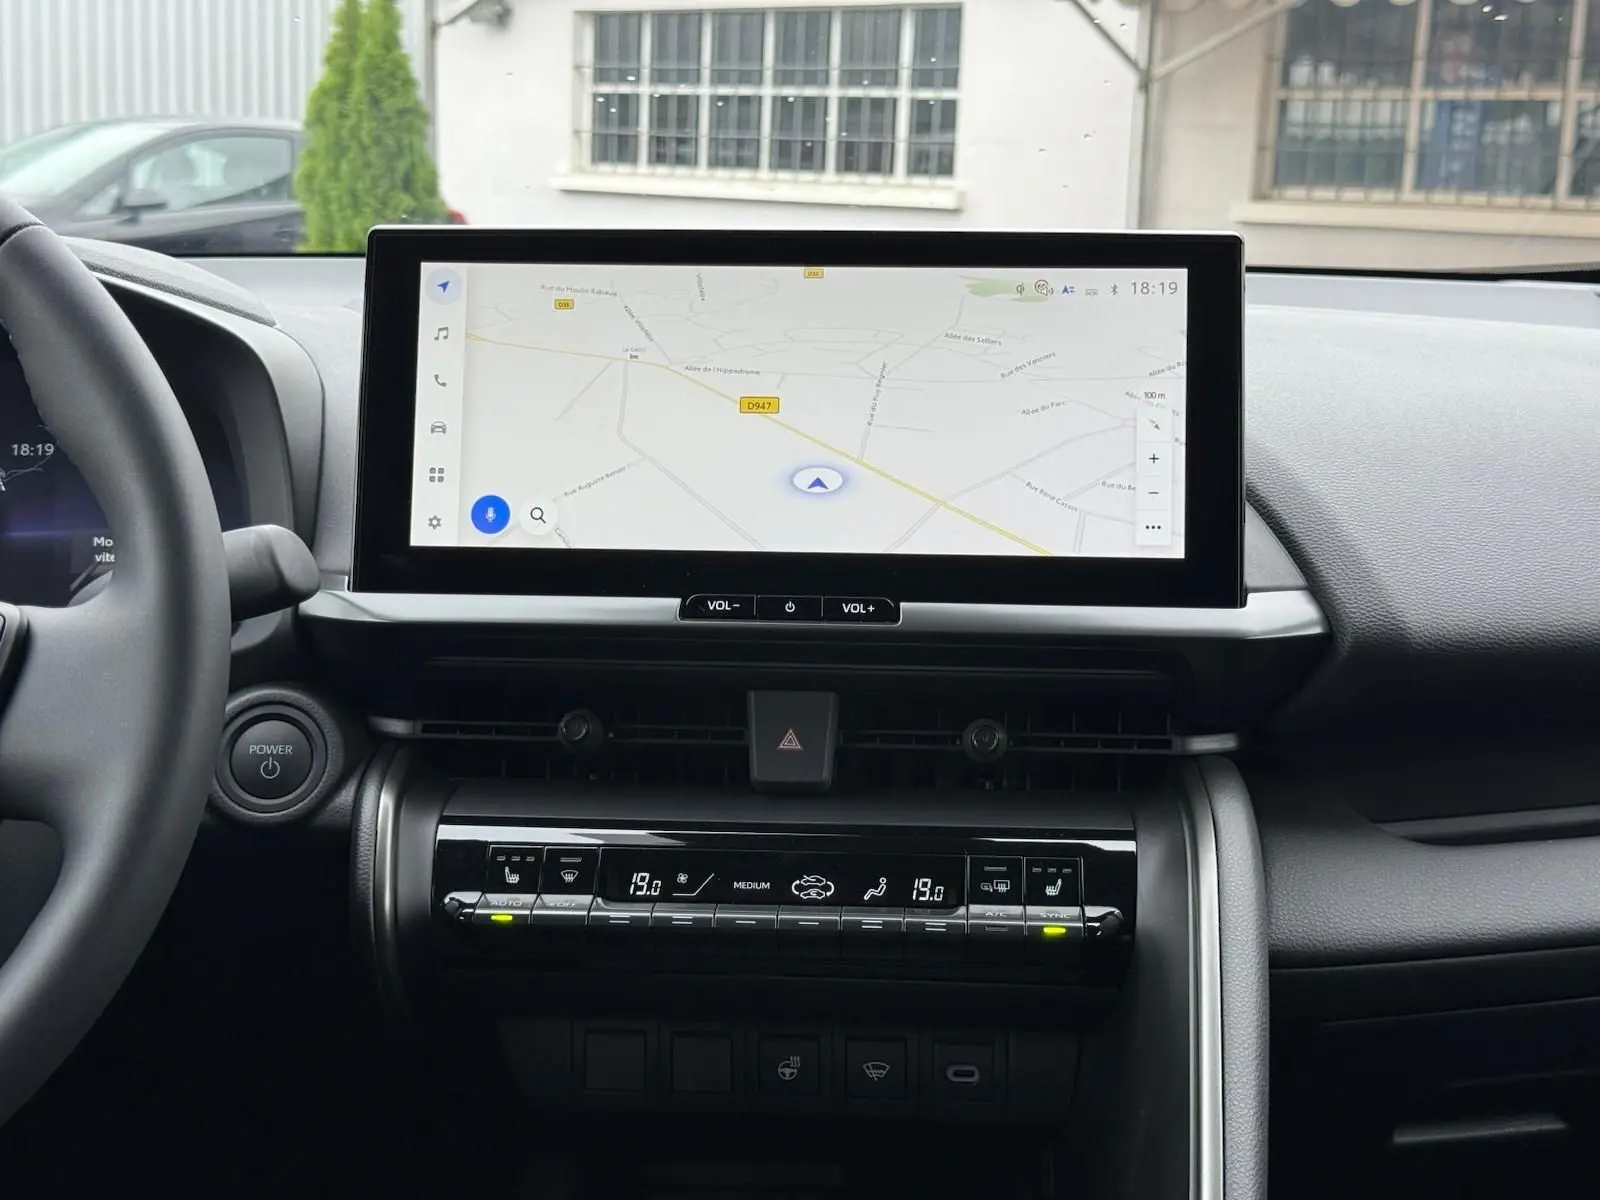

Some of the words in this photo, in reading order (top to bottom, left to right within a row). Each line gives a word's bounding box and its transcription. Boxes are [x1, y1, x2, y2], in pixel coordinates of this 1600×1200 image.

[1131, 281, 1178, 295] 18:19
[944, 332, 961, 341] Allée
[976, 336, 1002, 346] Selliers
[1000, 369, 1014, 379] Rue
[1014, 363, 1027, 372] des
[1026, 352, 1056, 367] Vanniers
[1148, 368, 1165, 378] Allée
[1144, 391, 1157, 400] 100
[1157, 392, 1166, 400] m
[747, 401, 772, 410] D947
[1020, 407, 1040, 416] Allée
[866, 413, 875, 426] Rue
[11, 443, 55, 456] 18:19
[1101, 480, 1115, 488] Rue
[1116, 482, 1126, 490] du
[564, 488, 577, 497] Rue
[1025, 481, 1039, 493] Rue
[1055, 498, 1078, 512] Cassin
[94, 536, 113, 547] Mo
[842, 603, 875, 614] VOL+
[249, 744, 293, 755] POWER
[629, 872, 662, 896] 19.0
[733, 881, 771, 890] MEDIUM
[912, 878, 945, 902] 19.0
[489, 899, 522, 907] AUTO
[1040, 911, 1071, 919] SYNC
